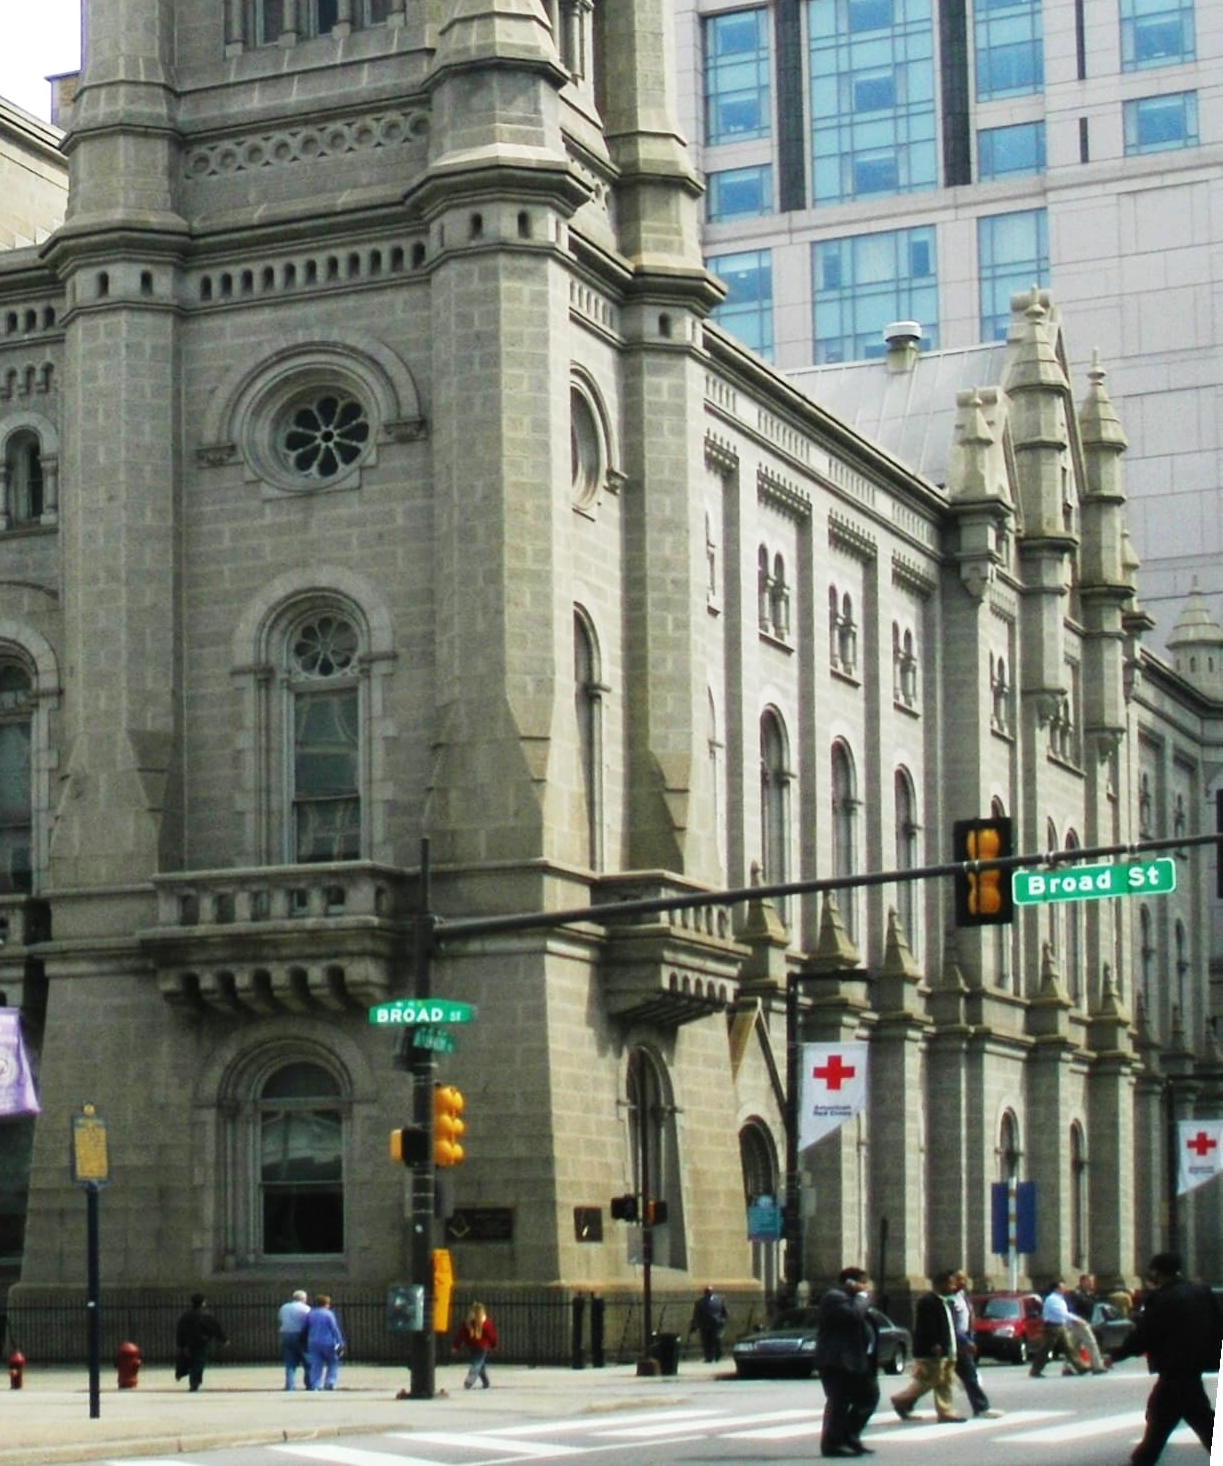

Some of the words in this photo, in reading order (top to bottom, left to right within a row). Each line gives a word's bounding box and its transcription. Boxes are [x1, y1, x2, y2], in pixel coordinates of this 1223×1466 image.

[1028, 869, 1112, 896] Broad
[1128, 865, 1160, 887] St
[376, 1007, 444, 1023] BROAD
